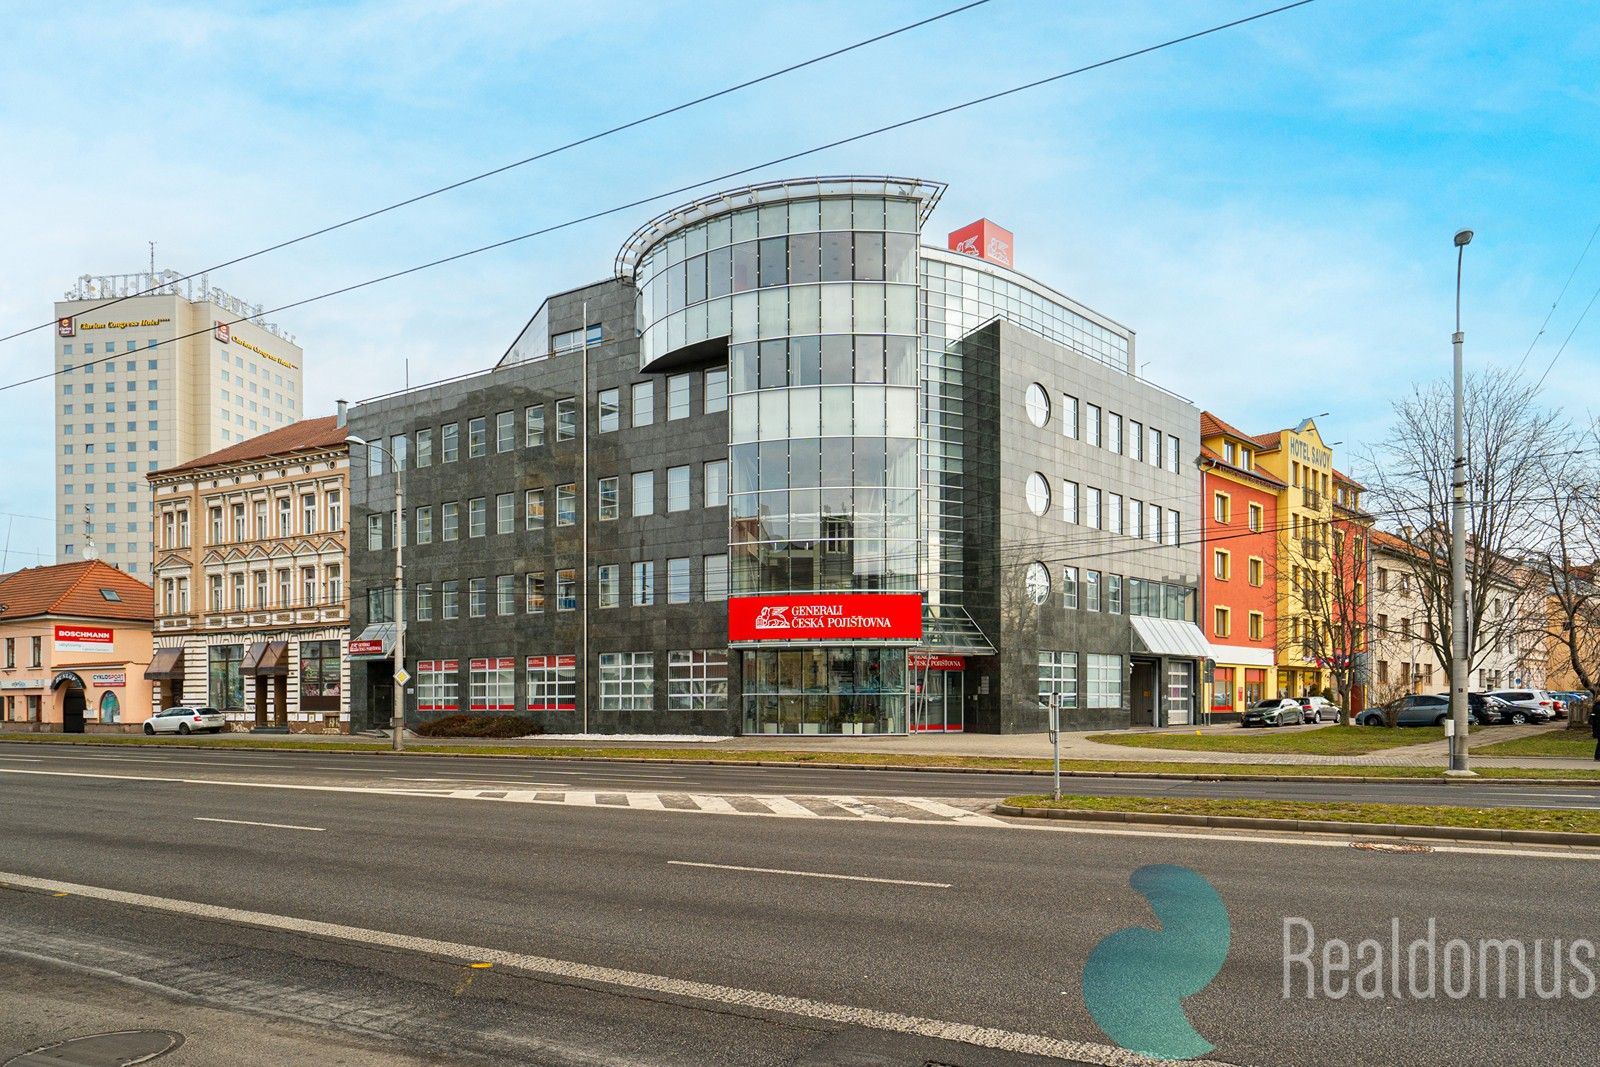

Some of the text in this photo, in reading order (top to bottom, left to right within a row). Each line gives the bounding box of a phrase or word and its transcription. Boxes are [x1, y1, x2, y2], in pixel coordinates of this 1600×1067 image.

[1290, 436, 1331, 469] HOTEL SAVOY
[791, 605, 843, 616] GENERALI
[791, 615, 892, 629] ČESKÁ POJIŠŤOVNA
[58, 630, 110, 639] BOSCHMANN
